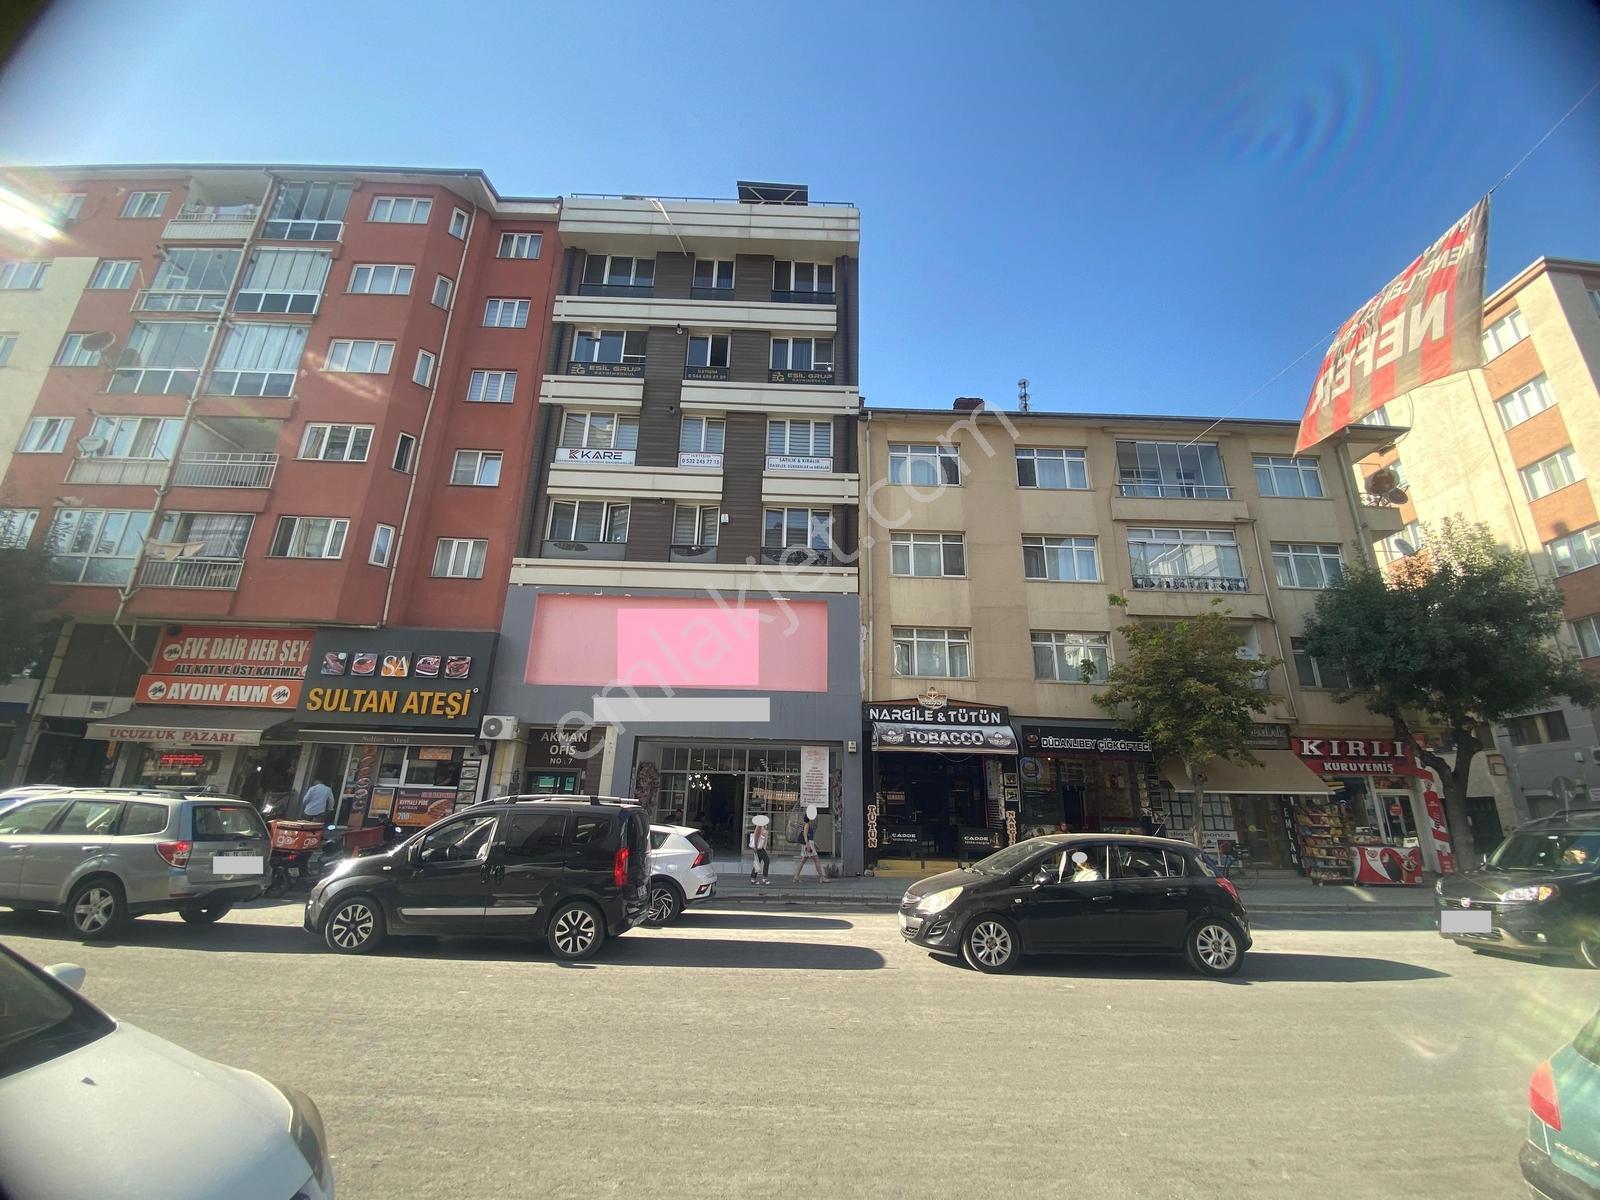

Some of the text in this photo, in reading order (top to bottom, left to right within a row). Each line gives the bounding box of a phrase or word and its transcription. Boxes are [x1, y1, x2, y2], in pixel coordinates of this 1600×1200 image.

[581, 451, 623, 460] KARE
[181, 634, 310, 665] EVE DAİR HER ŞEY
[174, 664, 301, 678] ALT KAT VE ÜST KATIMIZ
[167, 683, 269, 703] AYDIN AVM
[307, 687, 472, 719] SULTAN ATEŞİ
[869, 706, 1001, 724] NARGİLE & TÜTÜN
[109, 729, 237, 743] UCUZLUK PAZARI
[540, 731, 588, 743] AKMAN
[906, 730, 985, 746] TOBACCO
[549, 743, 577, 756] OFİS
[1300, 739, 1406, 758] KIRLI
[549, 757, 562, 765] NO
[1323, 761, 1394, 774] KURUYEMİŞ
[868, 805, 878, 849] TÜTÜN
[1283, 807, 1298, 864] EMLAK
